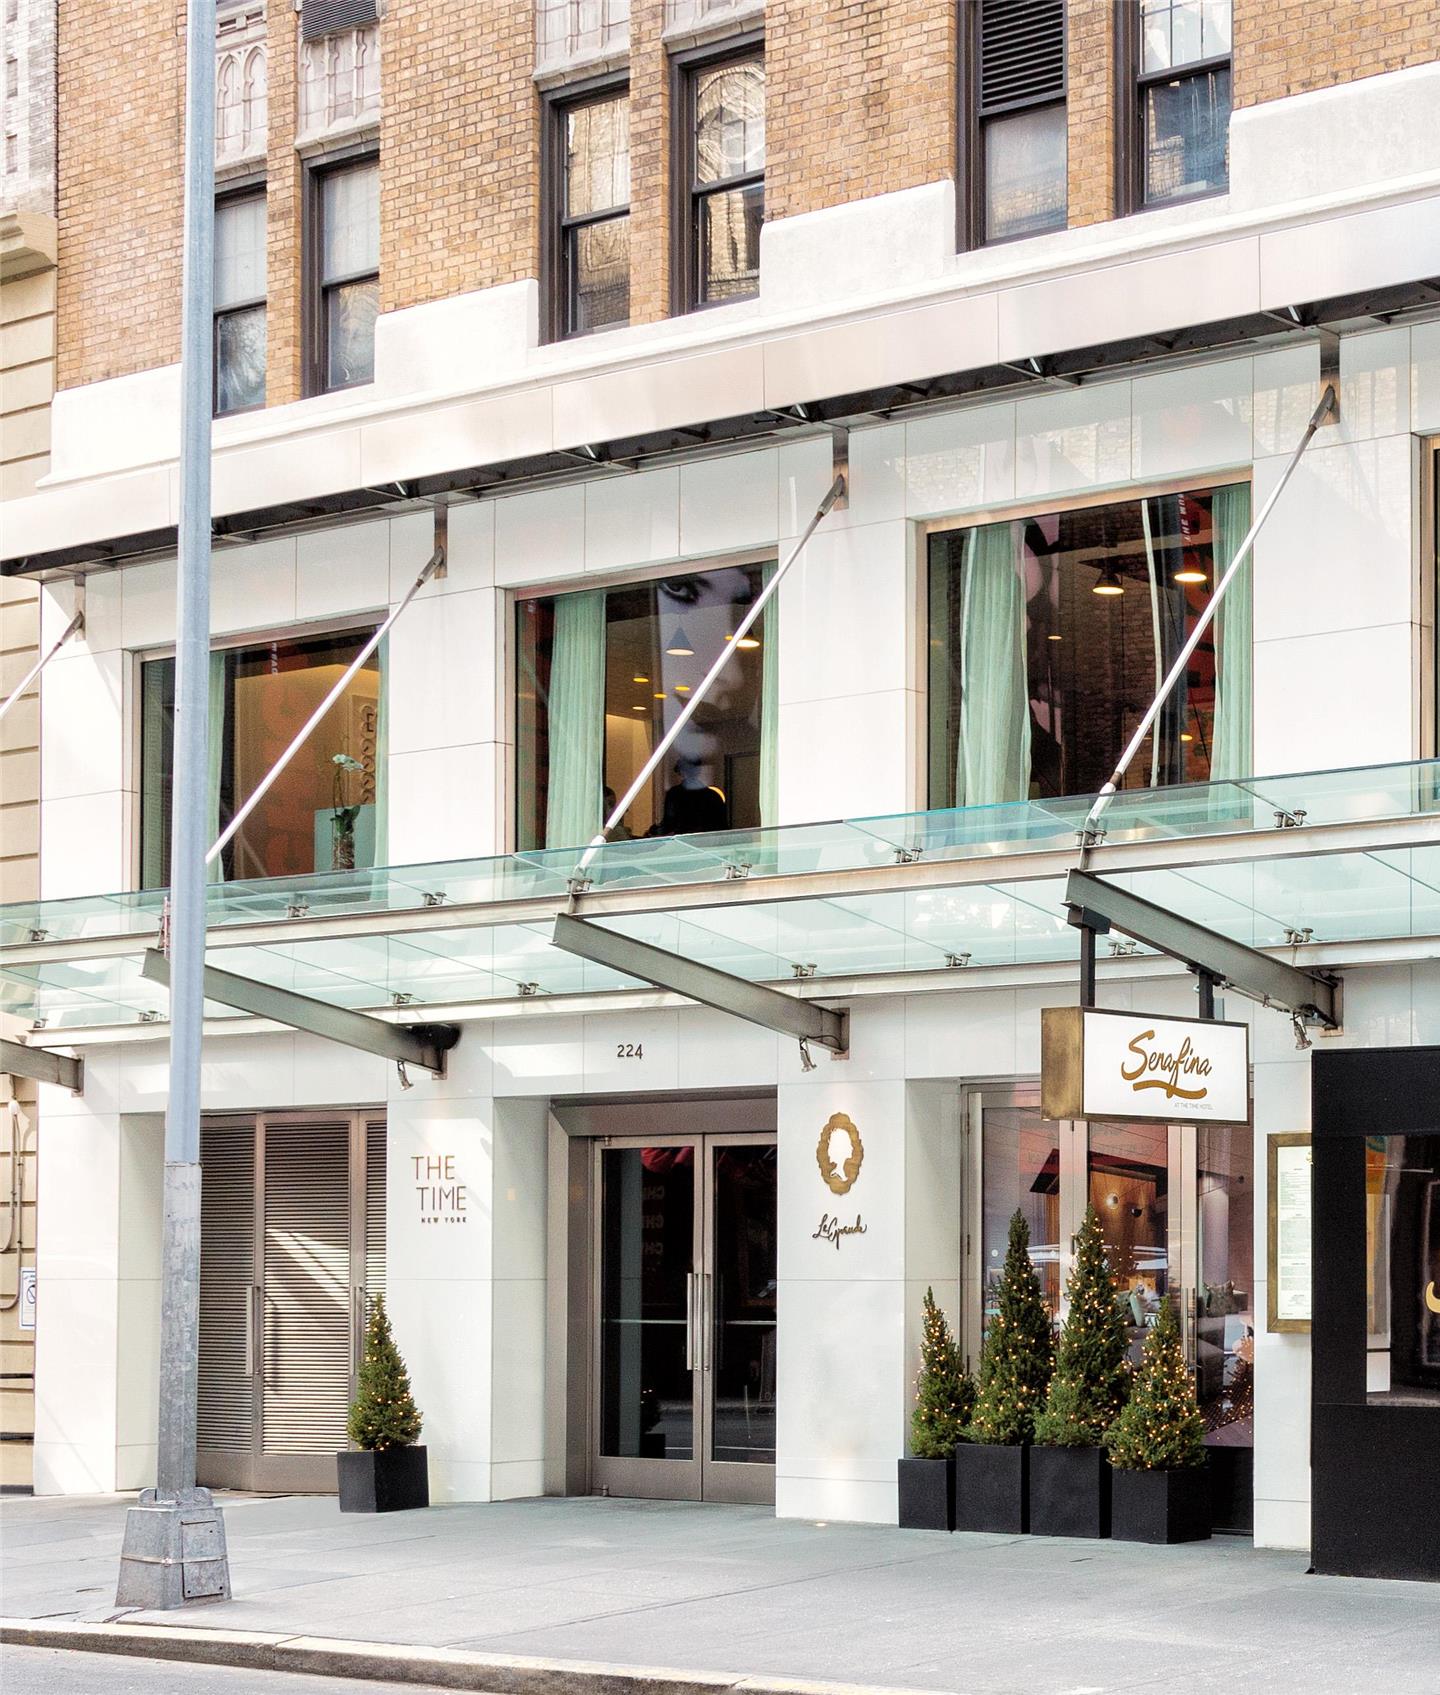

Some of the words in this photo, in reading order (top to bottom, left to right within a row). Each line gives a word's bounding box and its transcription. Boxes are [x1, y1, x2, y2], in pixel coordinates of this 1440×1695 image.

[617, 1043, 643, 1059] 224
[1121, 1030, 1212, 1099] Serafina
[410, 1155, 455, 1180] THE
[415, 1185, 467, 1211] TIME
[421, 1216, 439, 1224] NEW
[444, 1216, 467, 1224] YORK
[827, 1214, 868, 1250] Grande
